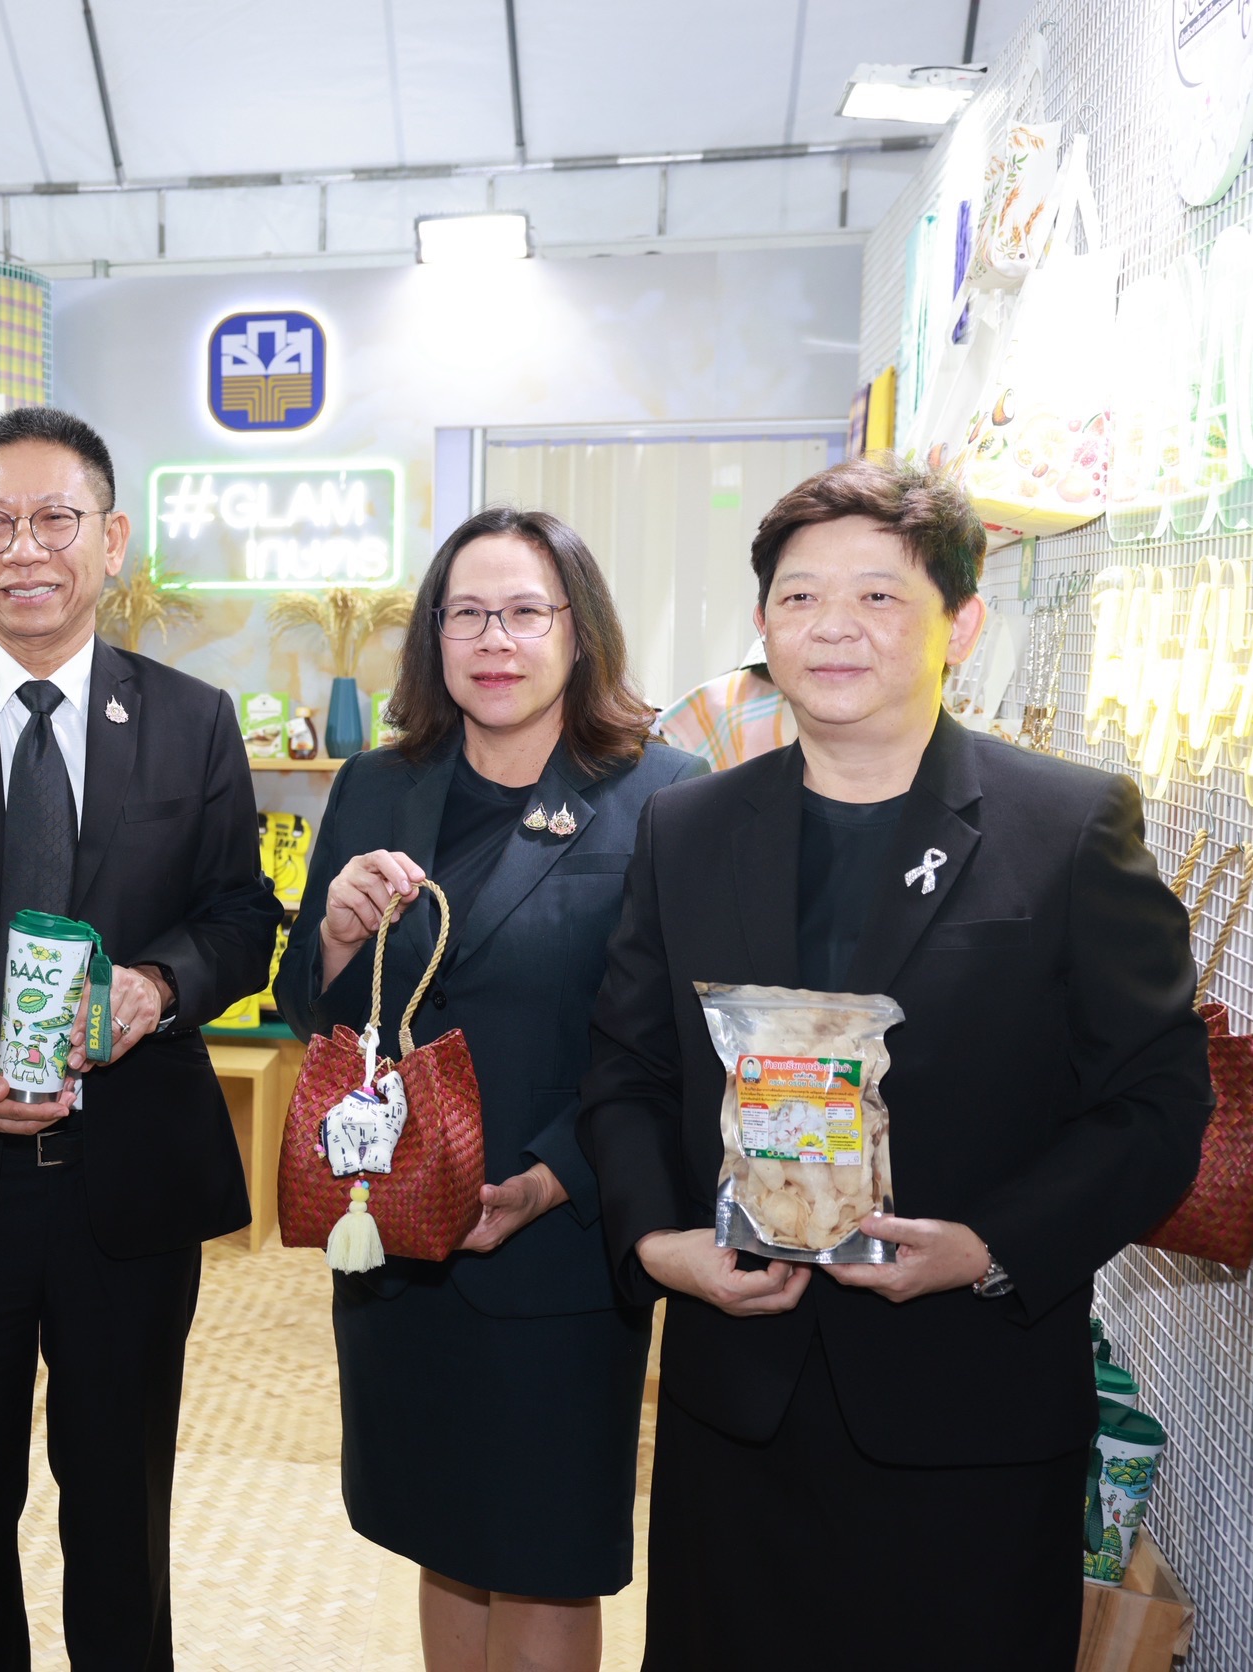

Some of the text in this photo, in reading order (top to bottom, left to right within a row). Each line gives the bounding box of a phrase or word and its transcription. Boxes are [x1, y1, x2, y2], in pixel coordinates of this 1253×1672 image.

[159, 474, 366, 538] #GLAM
[10, 959, 62, 986] BAAC
[89, 1004, 103, 1050] BAAC
